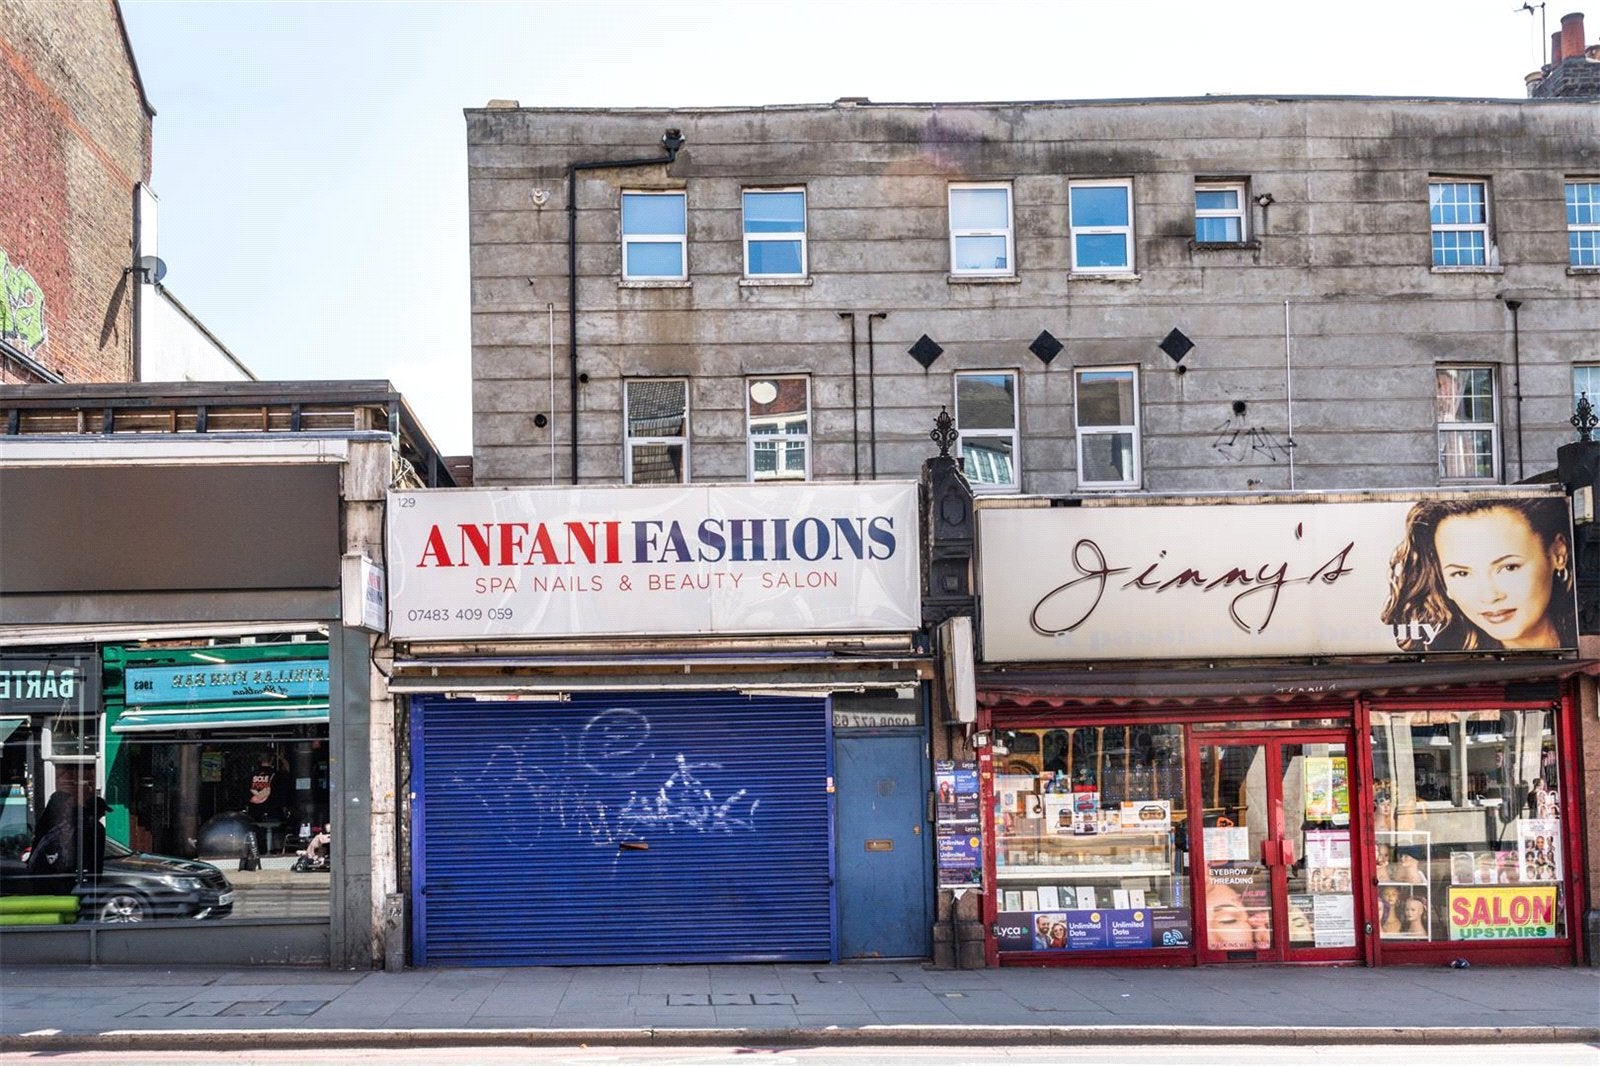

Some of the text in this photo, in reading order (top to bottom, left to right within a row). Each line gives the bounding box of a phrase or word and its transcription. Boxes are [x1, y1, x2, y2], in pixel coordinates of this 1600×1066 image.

[397, 497, 416, 508] 129
[416, 516, 896, 567] ANFANI FASHIONS
[475, 571, 837, 594] SPA NAILS & BEAUTY SALON
[1030, 522, 1355, 637] Jinny's
[408, 607, 513, 622] 07483 409 059
[1209, 876, 1254, 885] THREADING
[1452, 895, 1554, 926] SALON
[1069, 929, 1087, 937] Data
[1112, 928, 1130, 936] Data
[1459, 926, 1548, 939] UPSTAIRS
